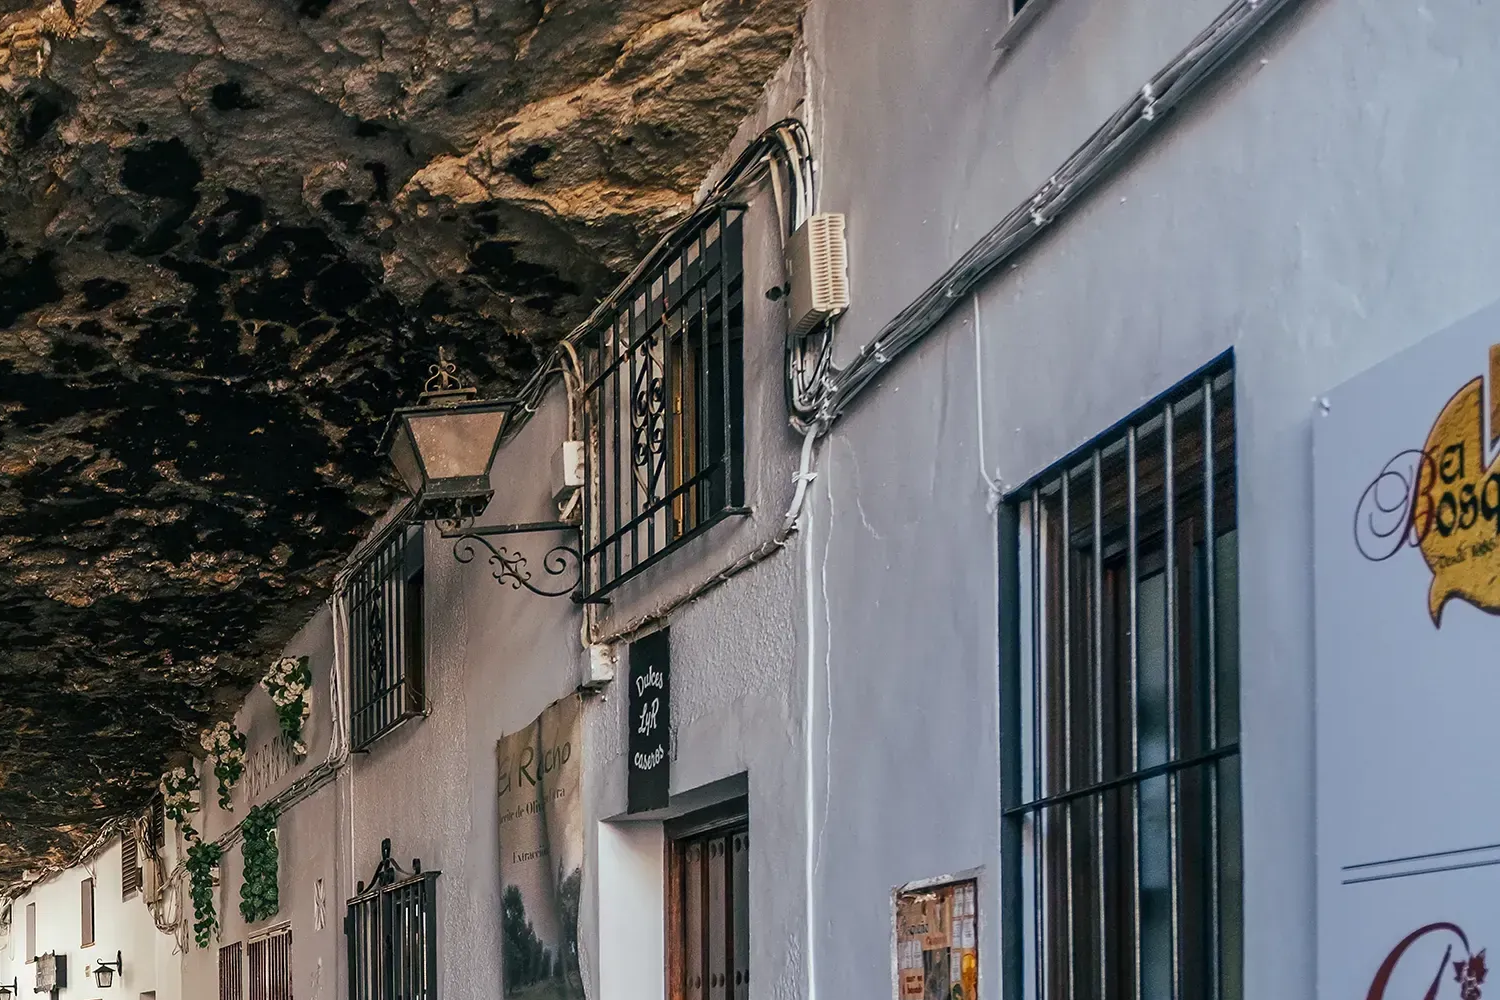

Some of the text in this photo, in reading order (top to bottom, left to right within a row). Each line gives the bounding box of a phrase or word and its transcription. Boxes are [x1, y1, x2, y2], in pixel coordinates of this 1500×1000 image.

[635, 665, 664, 697] Dulces
[637, 697, 660, 737] LyR
[634, 743, 664, 770] caseros
